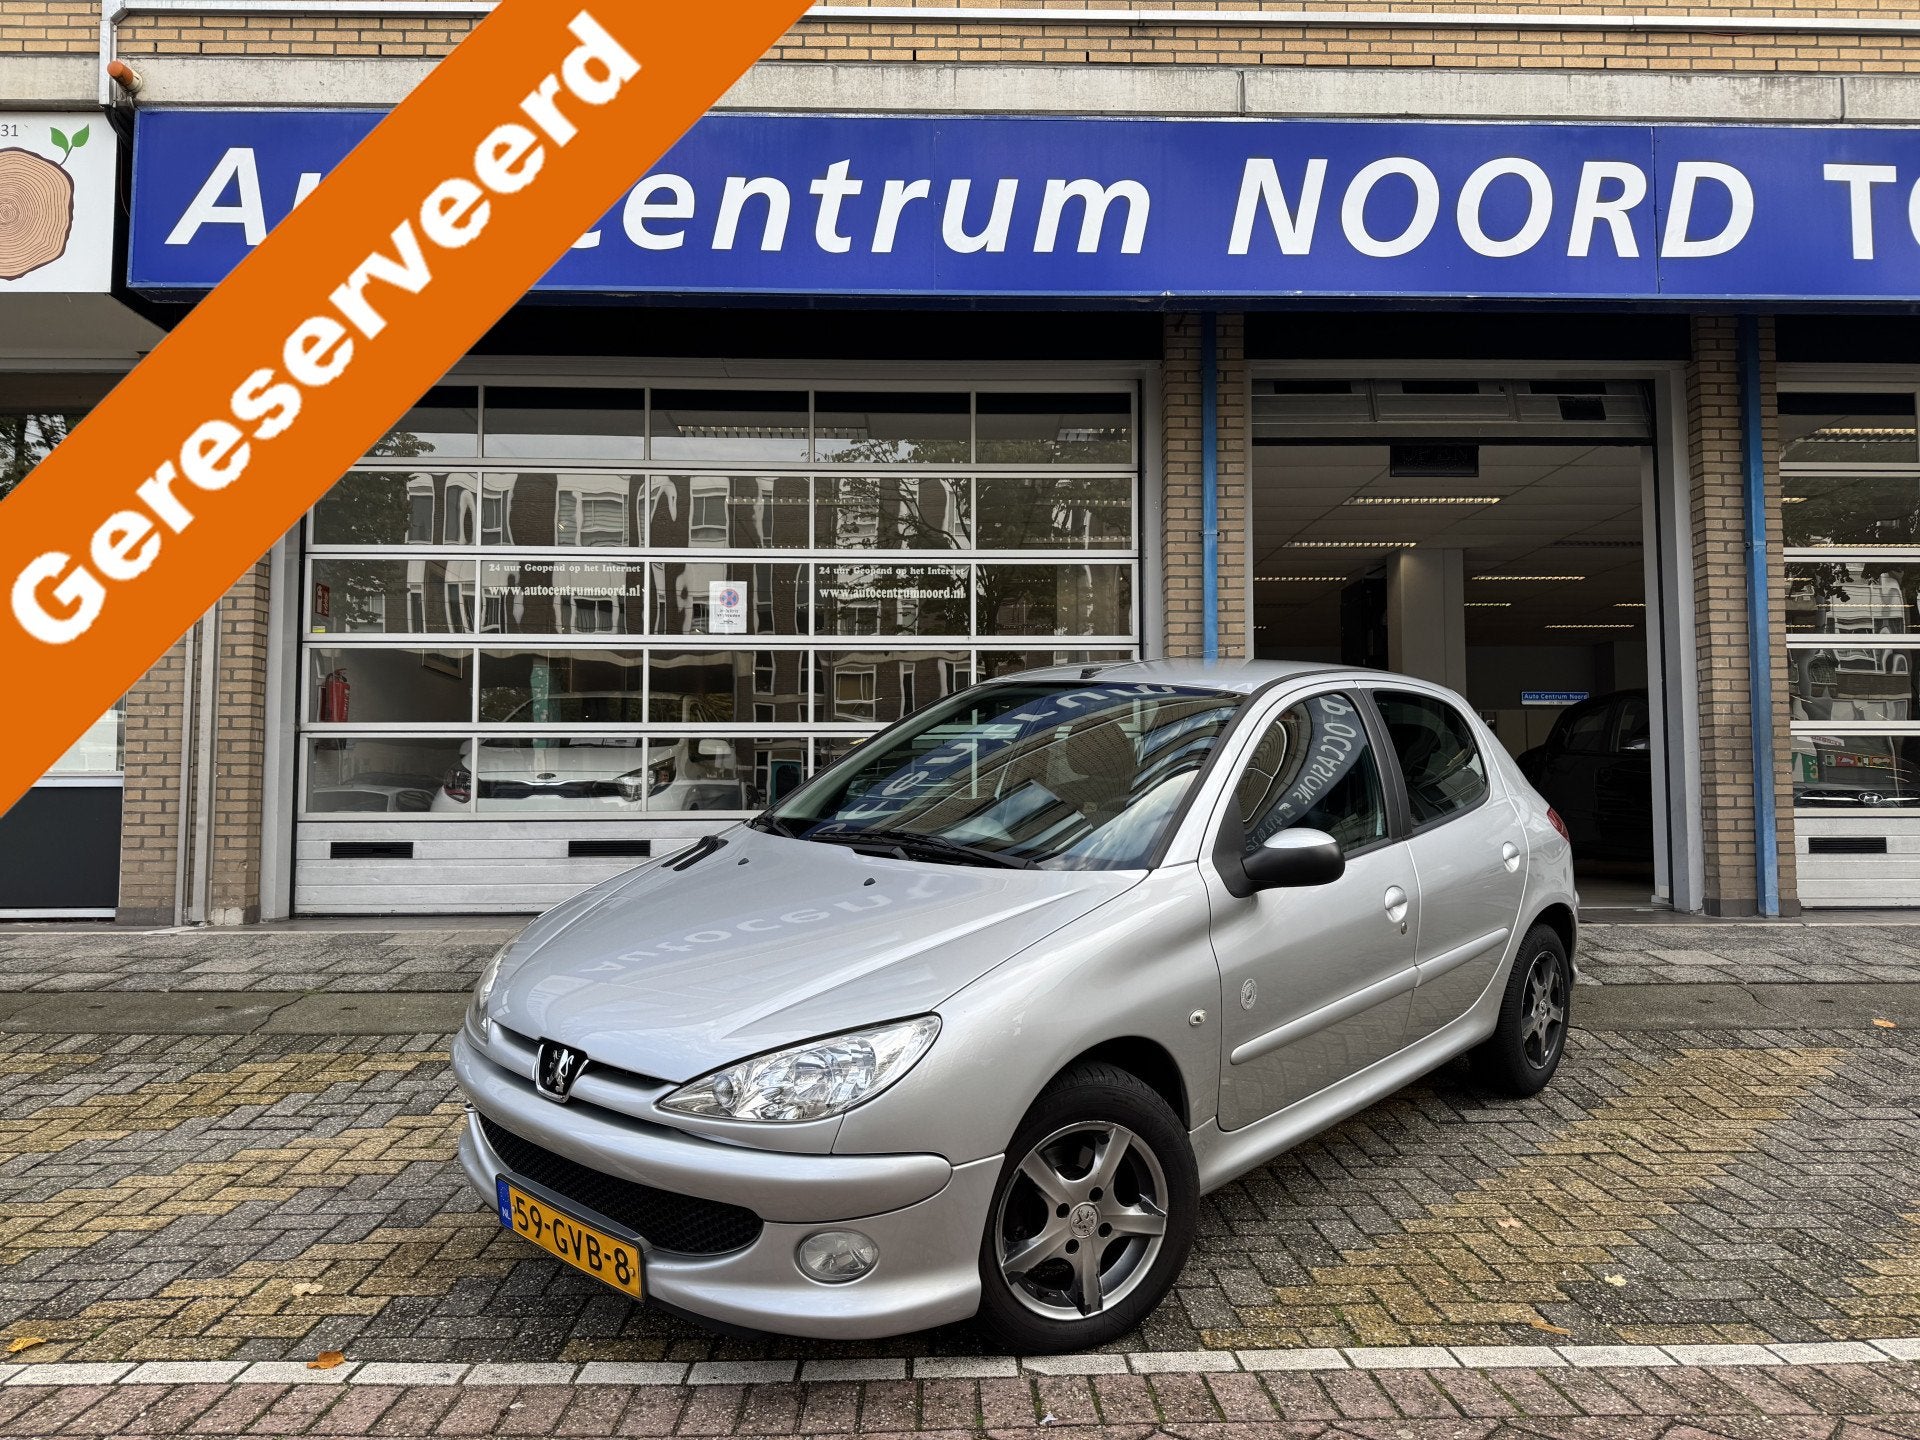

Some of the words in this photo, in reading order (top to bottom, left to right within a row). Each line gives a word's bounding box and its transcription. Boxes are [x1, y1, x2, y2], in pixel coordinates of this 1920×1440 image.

[164, 147, 1151, 255] Aentrum
[1227, 156, 1754, 258] NOORD
[1823, 163, 1920, 260] T
[488, 563, 500, 572] 24
[503, 564, 521, 572] uur
[524, 563, 565, 573] Geopend
[569, 564, 581, 573] op
[584, 563, 599, 572] het
[602, 564, 641, 573] Internet
[818, 566, 830, 575] 24
[833, 567, 850, 575] uur
[853, 566, 893, 576] Geopend
[895, 566, 907, 576] op
[910, 566, 925, 575] het
[488, 584, 641, 597] www.autocentrumnoord.nl
[819, 586, 966, 599] www.autocentrumnoord.nl
[515, 1195, 631, 1285] 59-GVB-8
